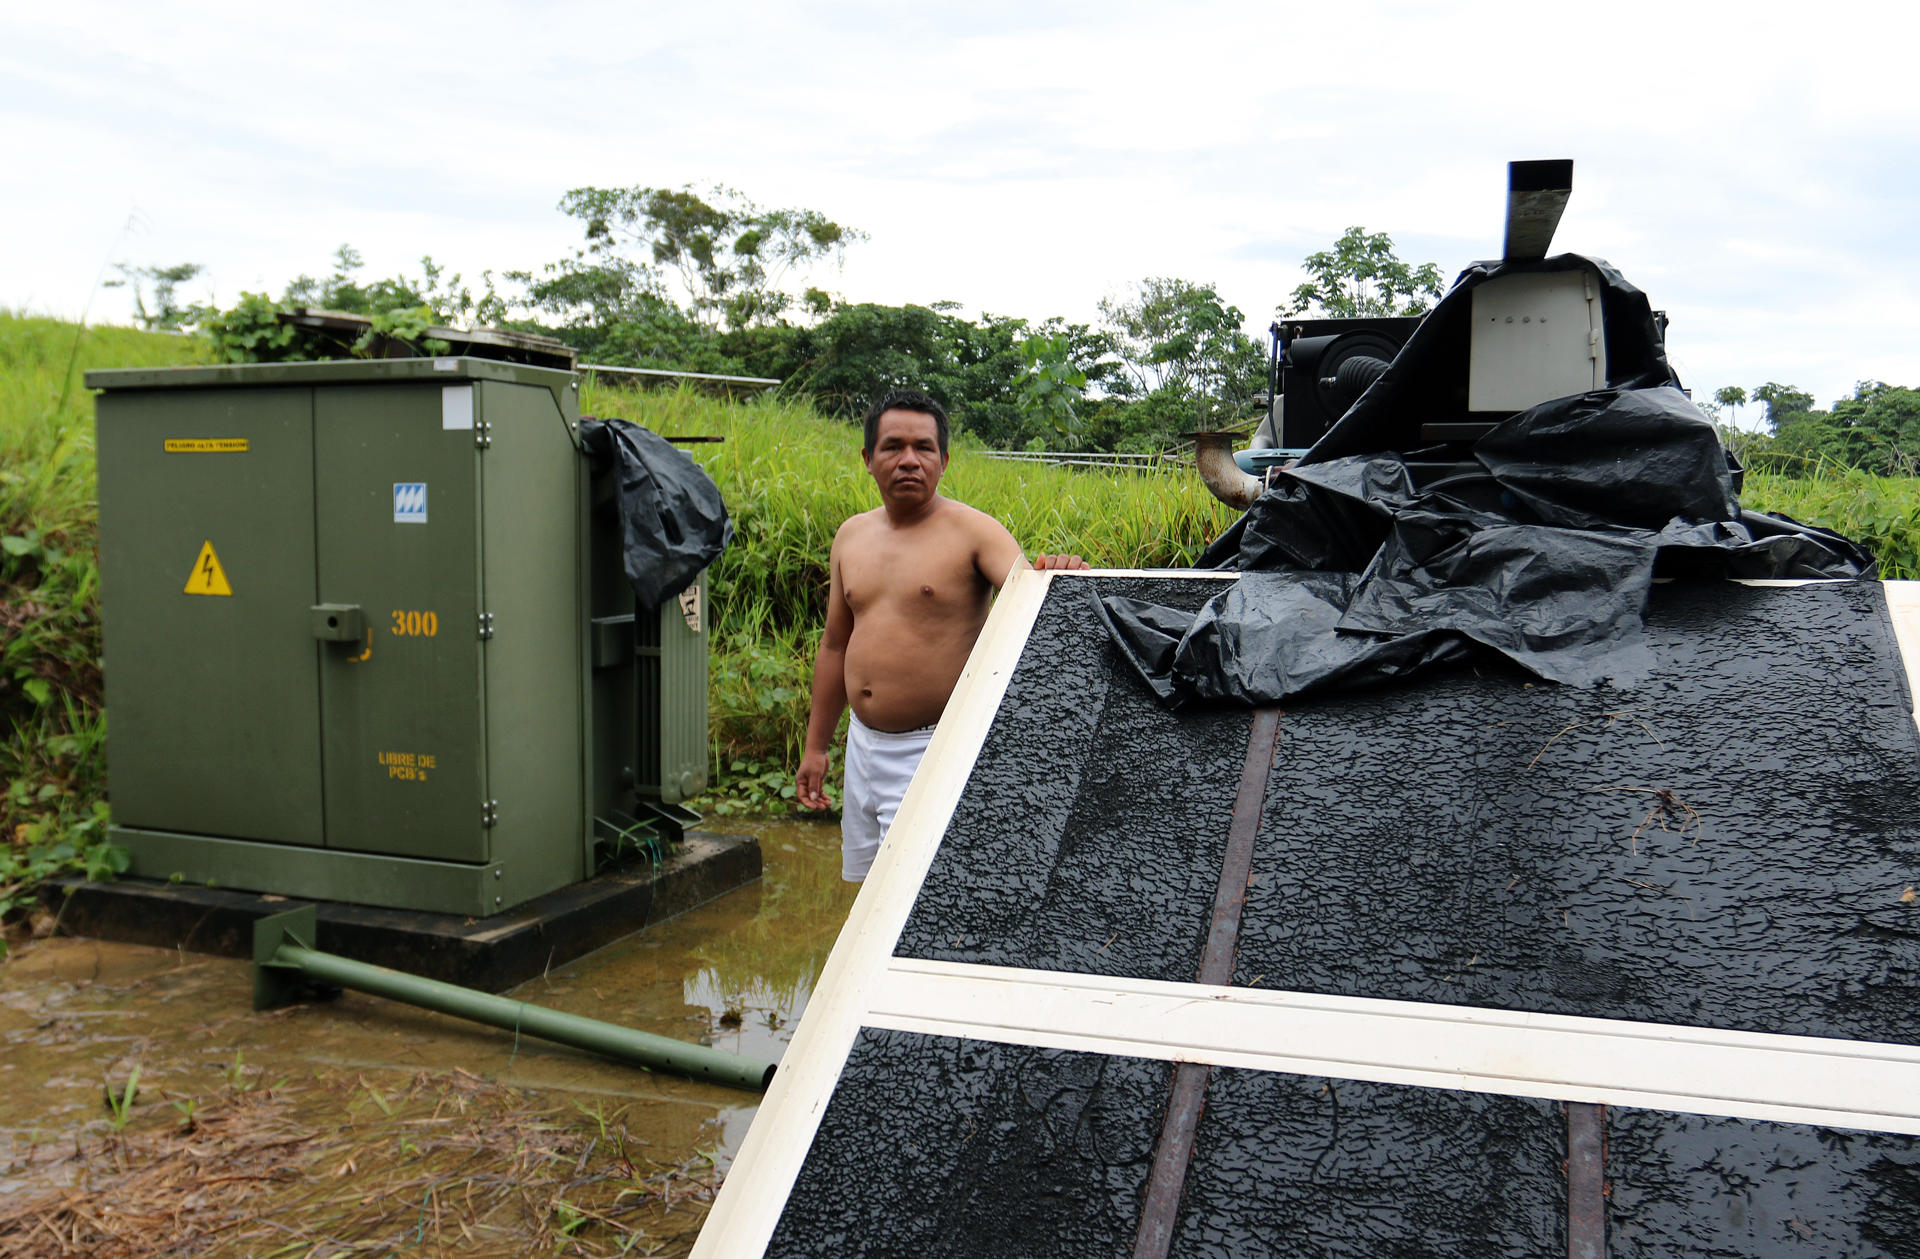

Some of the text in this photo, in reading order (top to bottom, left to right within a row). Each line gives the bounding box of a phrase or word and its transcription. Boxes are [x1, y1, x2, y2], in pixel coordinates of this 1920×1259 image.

[391, 610, 438, 637] 300
[378, 751, 436, 769] LIBRE DE
